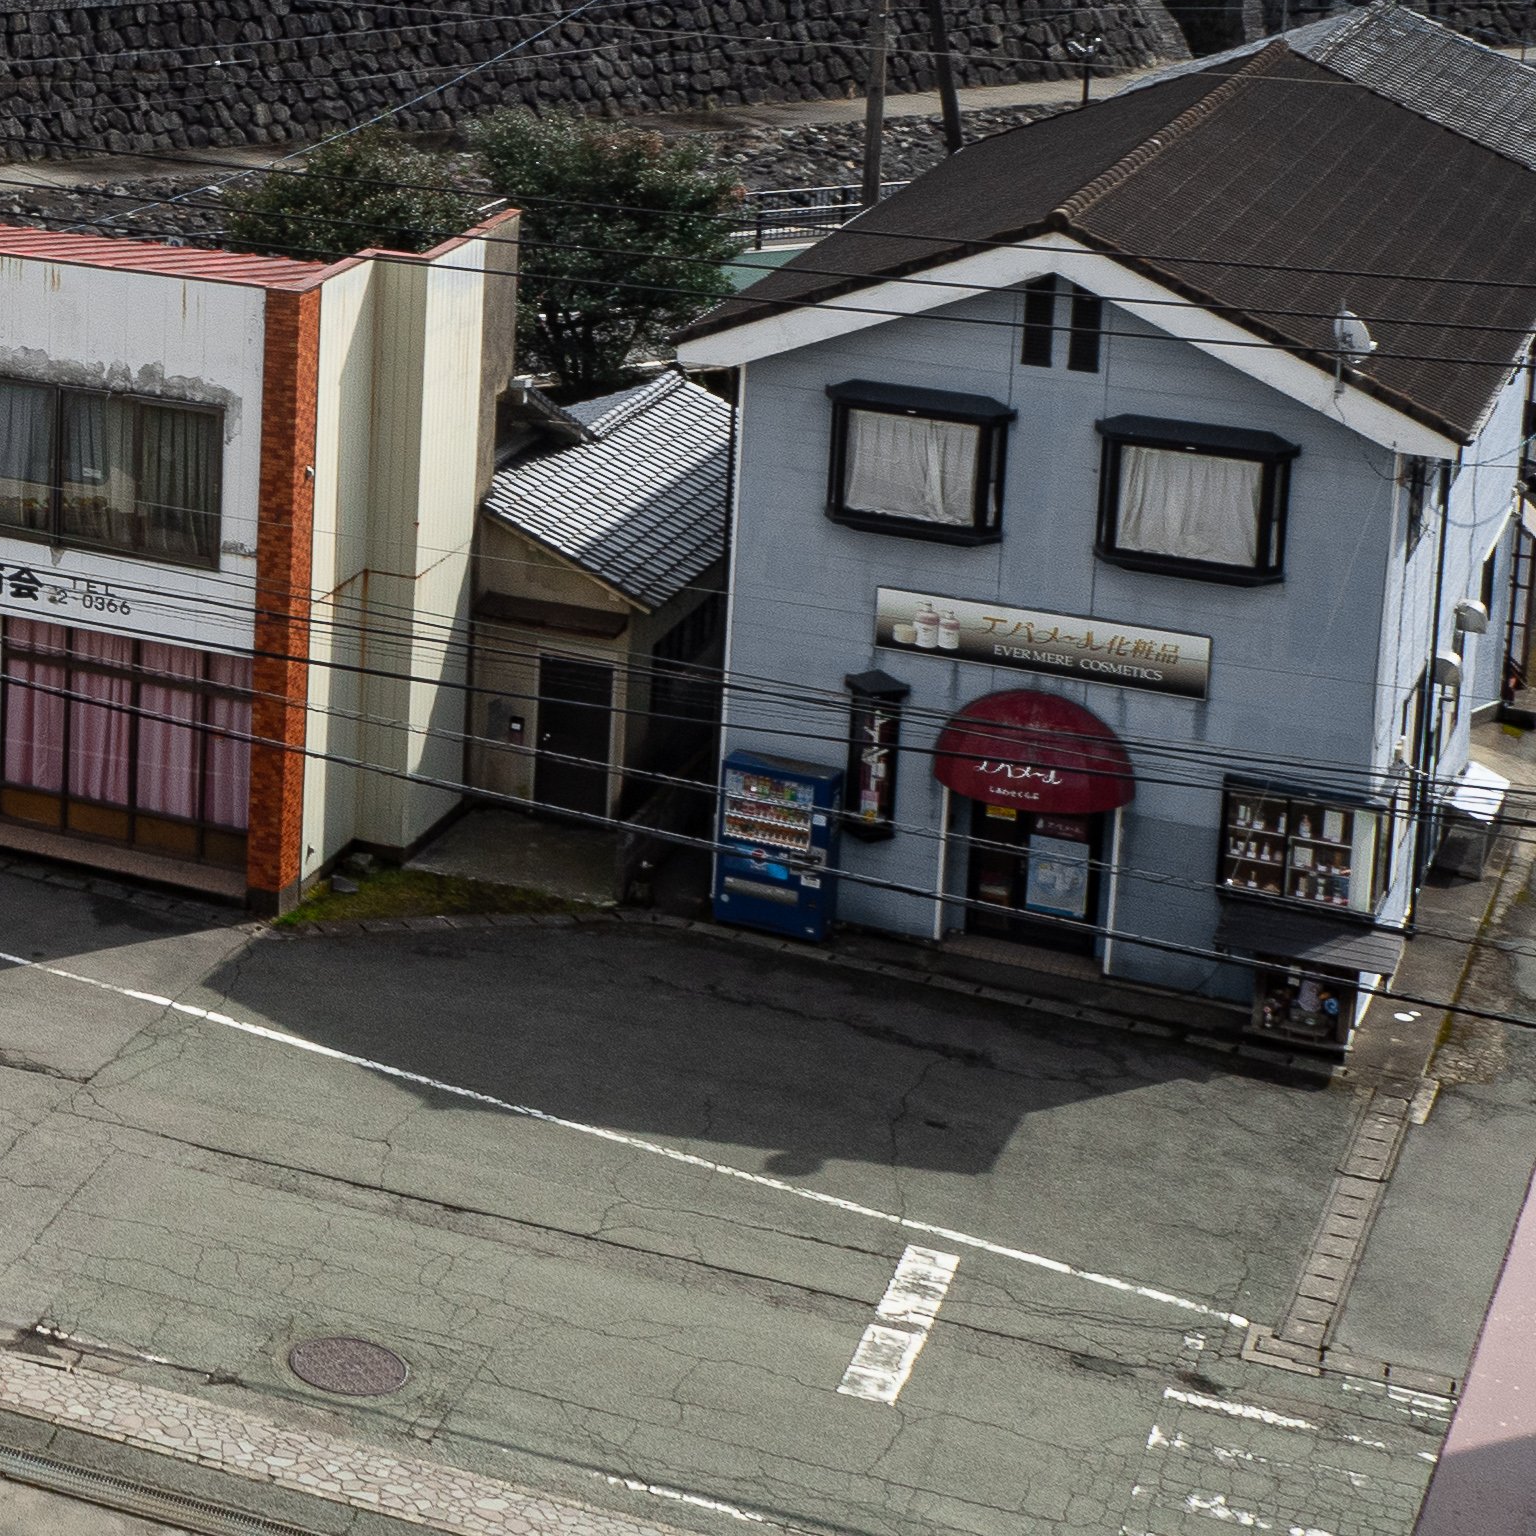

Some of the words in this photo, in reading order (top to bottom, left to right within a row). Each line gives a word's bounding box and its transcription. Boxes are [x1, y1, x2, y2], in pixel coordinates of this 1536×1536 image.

[71, 575, 117, 598] TEL
[980, 615, 1180, 665] エバメール化粧品
[1080, 658, 1163, 682] COSMETICS
